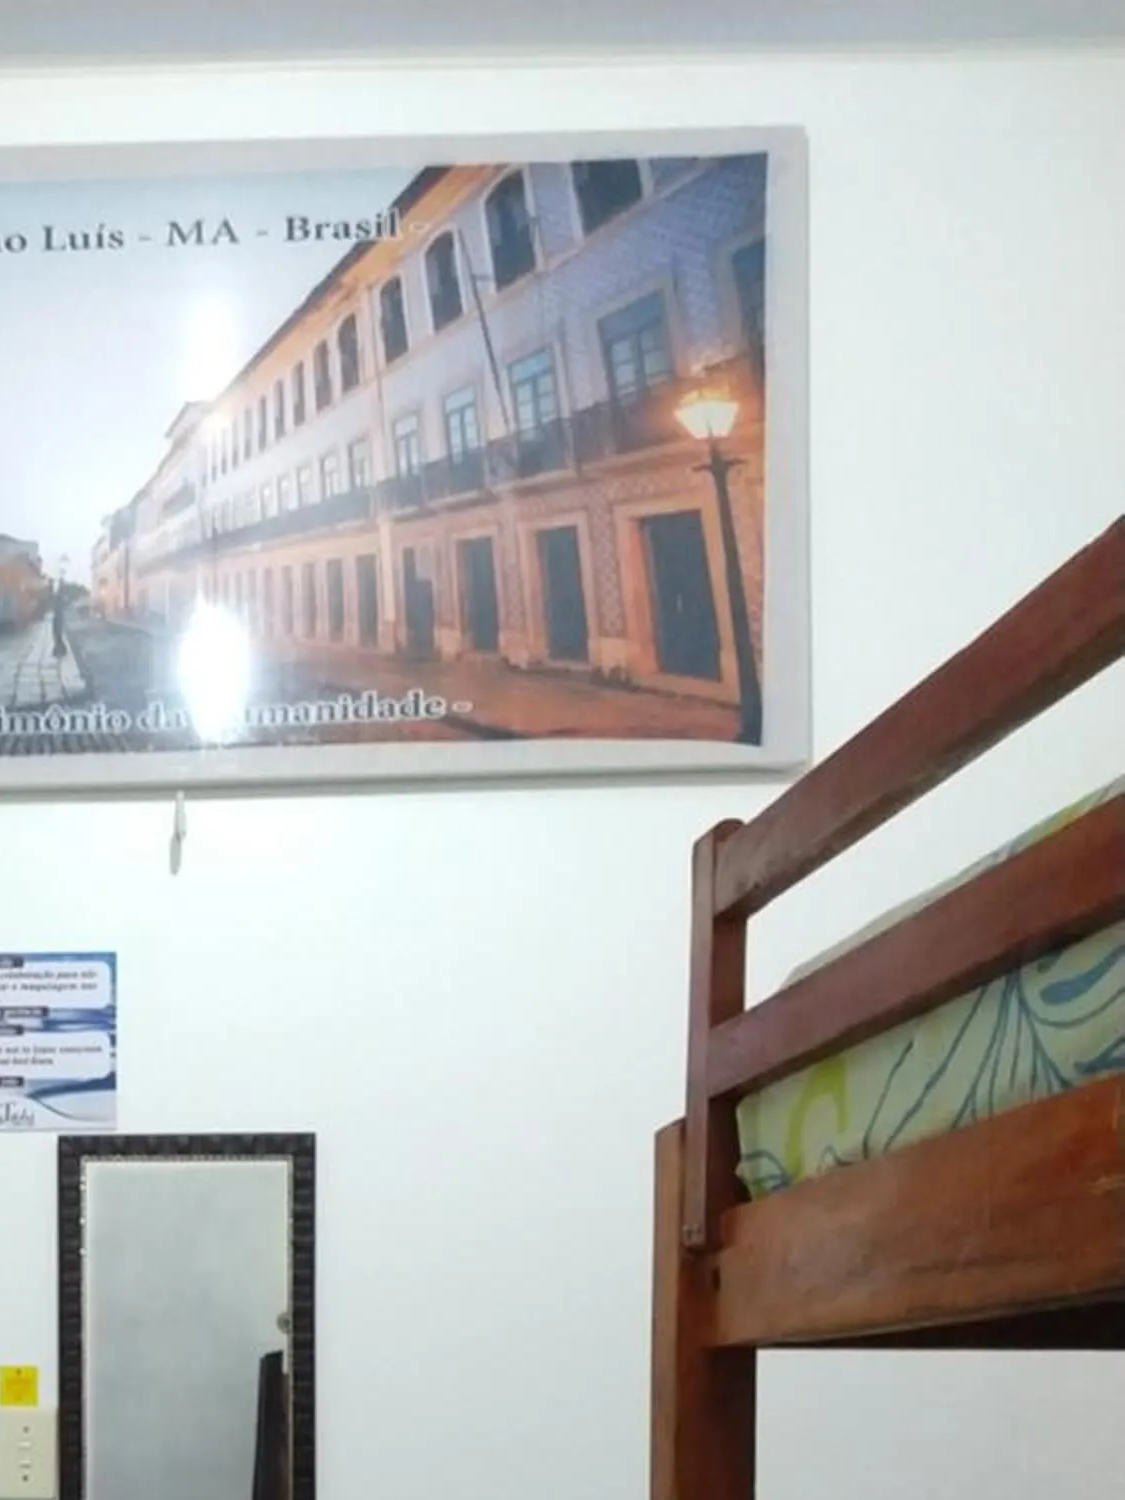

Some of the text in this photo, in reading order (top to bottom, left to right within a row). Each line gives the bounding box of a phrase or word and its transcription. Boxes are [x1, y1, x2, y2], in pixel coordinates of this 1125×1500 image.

[41, 223, 125, 252] Luís
[167, 218, 241, 247] MA
[283, 209, 401, 243] Brasil
[233, 687, 448, 727] manidade
